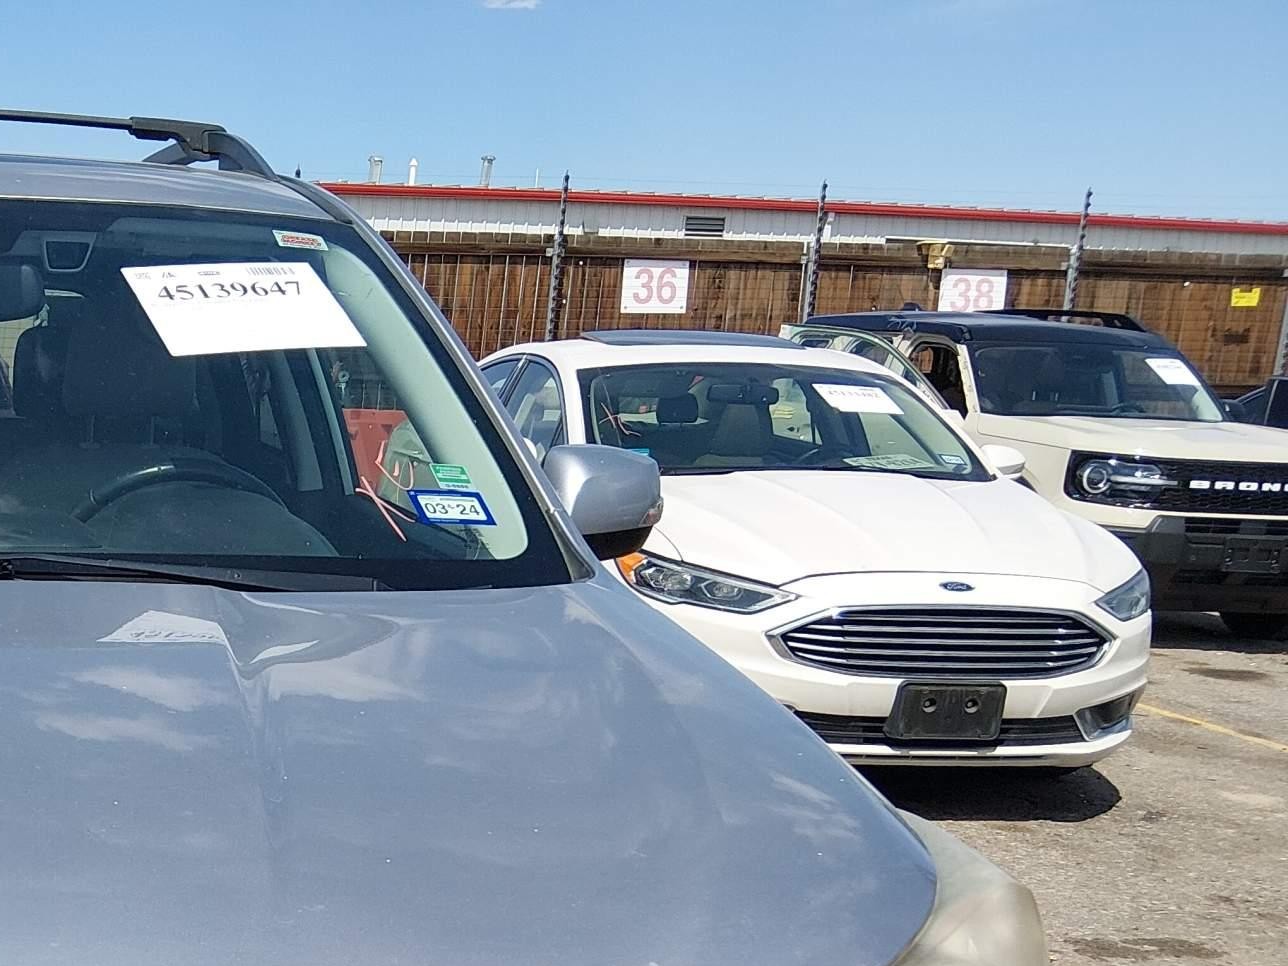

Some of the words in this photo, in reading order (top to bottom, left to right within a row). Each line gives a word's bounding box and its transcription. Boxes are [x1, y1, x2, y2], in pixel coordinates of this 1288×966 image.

[158, 281, 300, 300] 45139647
[633, 267, 677, 304] 36
[950, 278, 994, 312] 38
[1189, 481, 1288, 492] BRON
[424, 503, 449, 515] 03
[456, 504, 480, 516] 24
